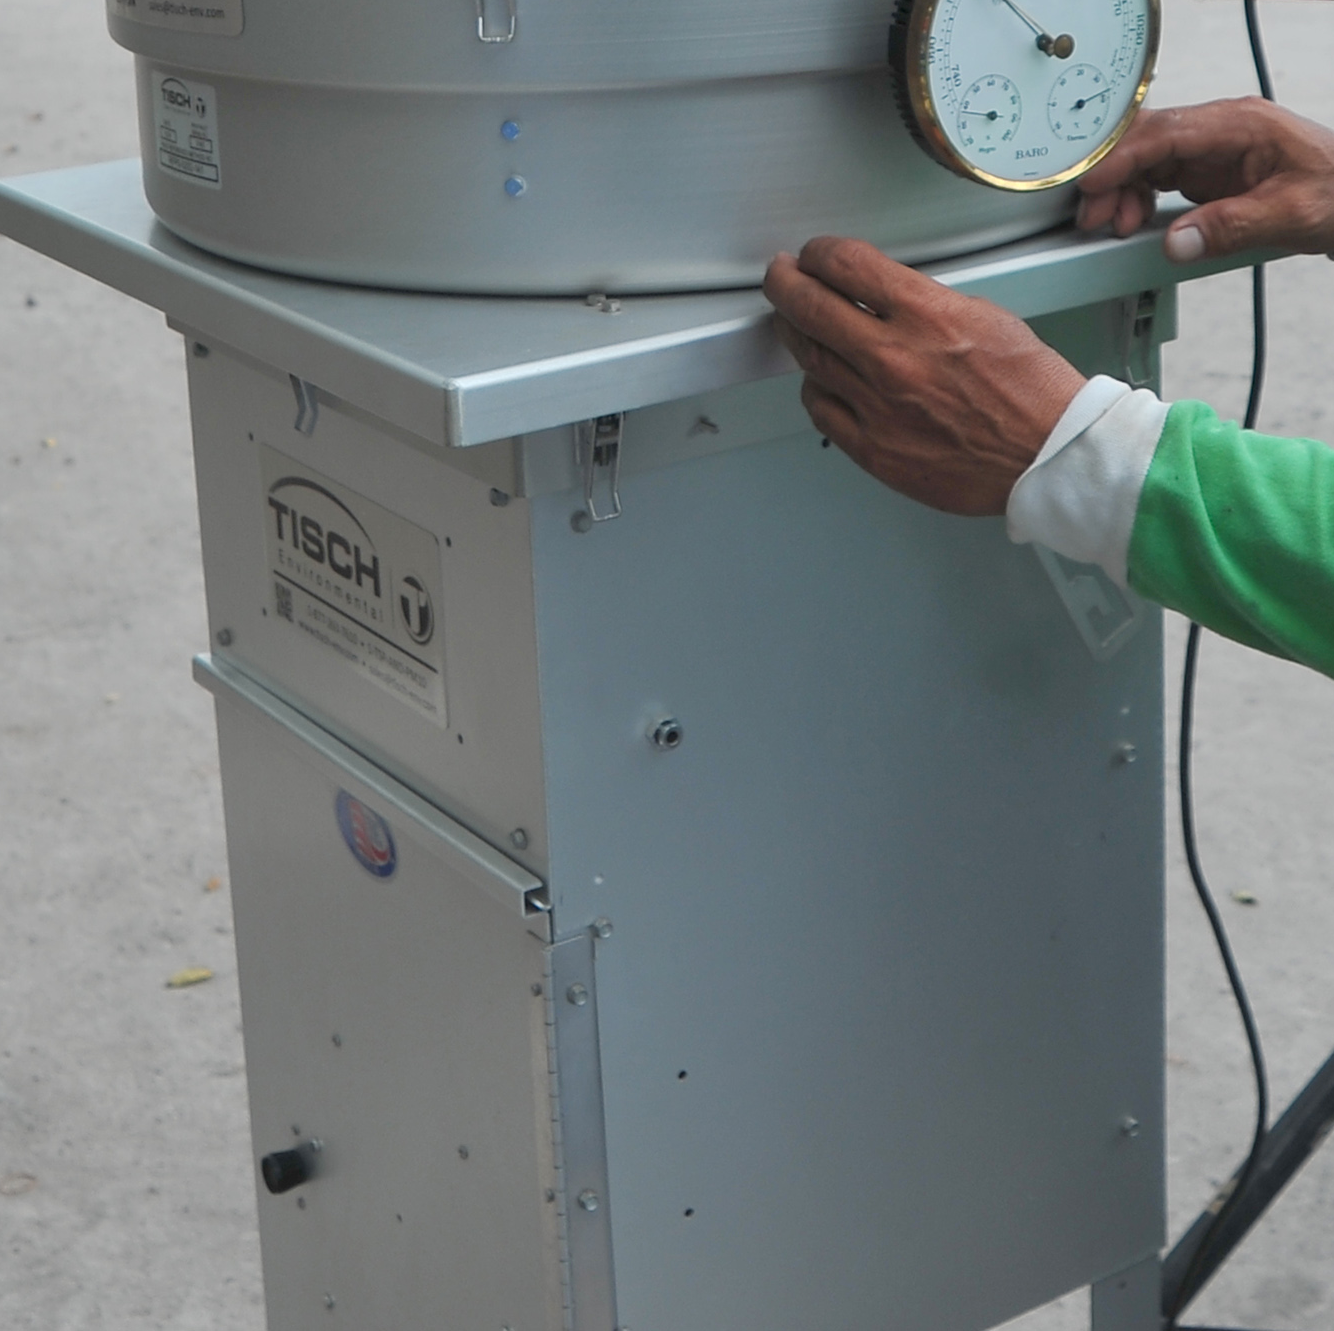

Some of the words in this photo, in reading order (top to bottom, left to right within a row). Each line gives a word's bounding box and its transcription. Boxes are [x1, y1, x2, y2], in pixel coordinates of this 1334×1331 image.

[1135, 13, 1146, 45] 1030
[161, 87, 191, 109] TISCH
[1014, 146, 1049, 160] BARO
[268, 495, 382, 599] TISCH
